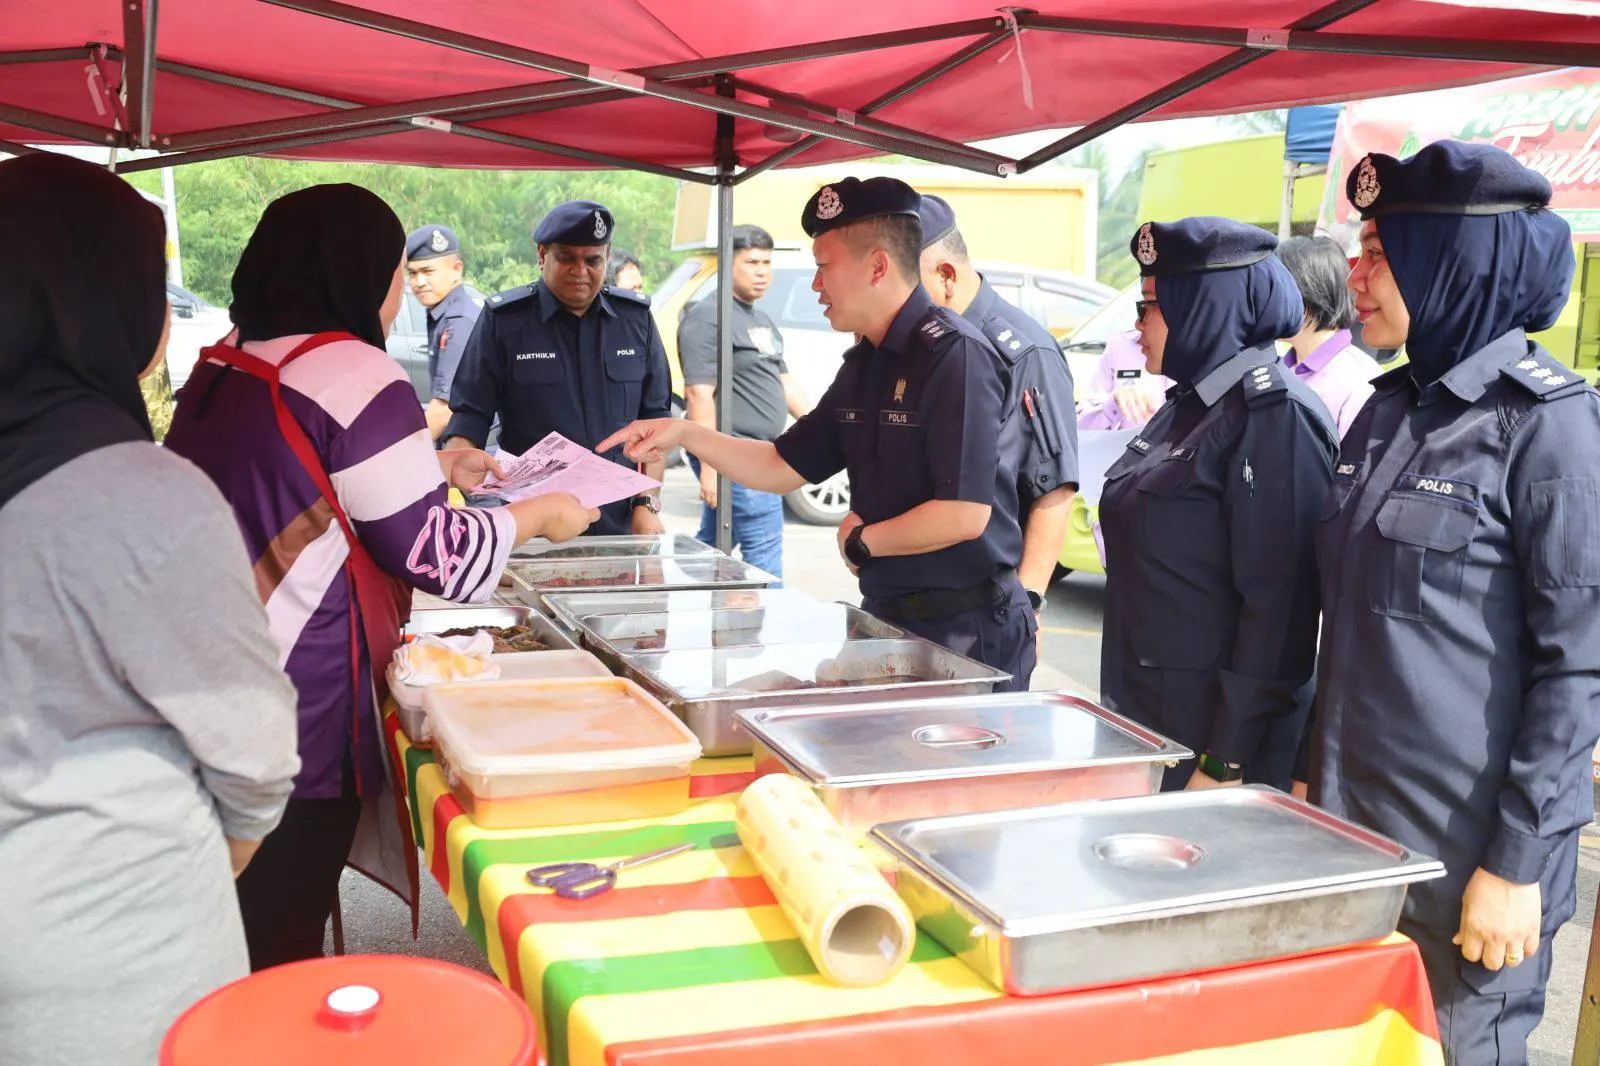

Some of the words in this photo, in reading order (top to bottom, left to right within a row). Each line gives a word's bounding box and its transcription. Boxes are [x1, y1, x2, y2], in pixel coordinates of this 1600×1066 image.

[516, 352, 556, 361] KARTHIK.W
[616, 349, 635, 357] POLIS
[888, 413, 908, 423] POLIS
[1416, 479, 1455, 495] POLIS
